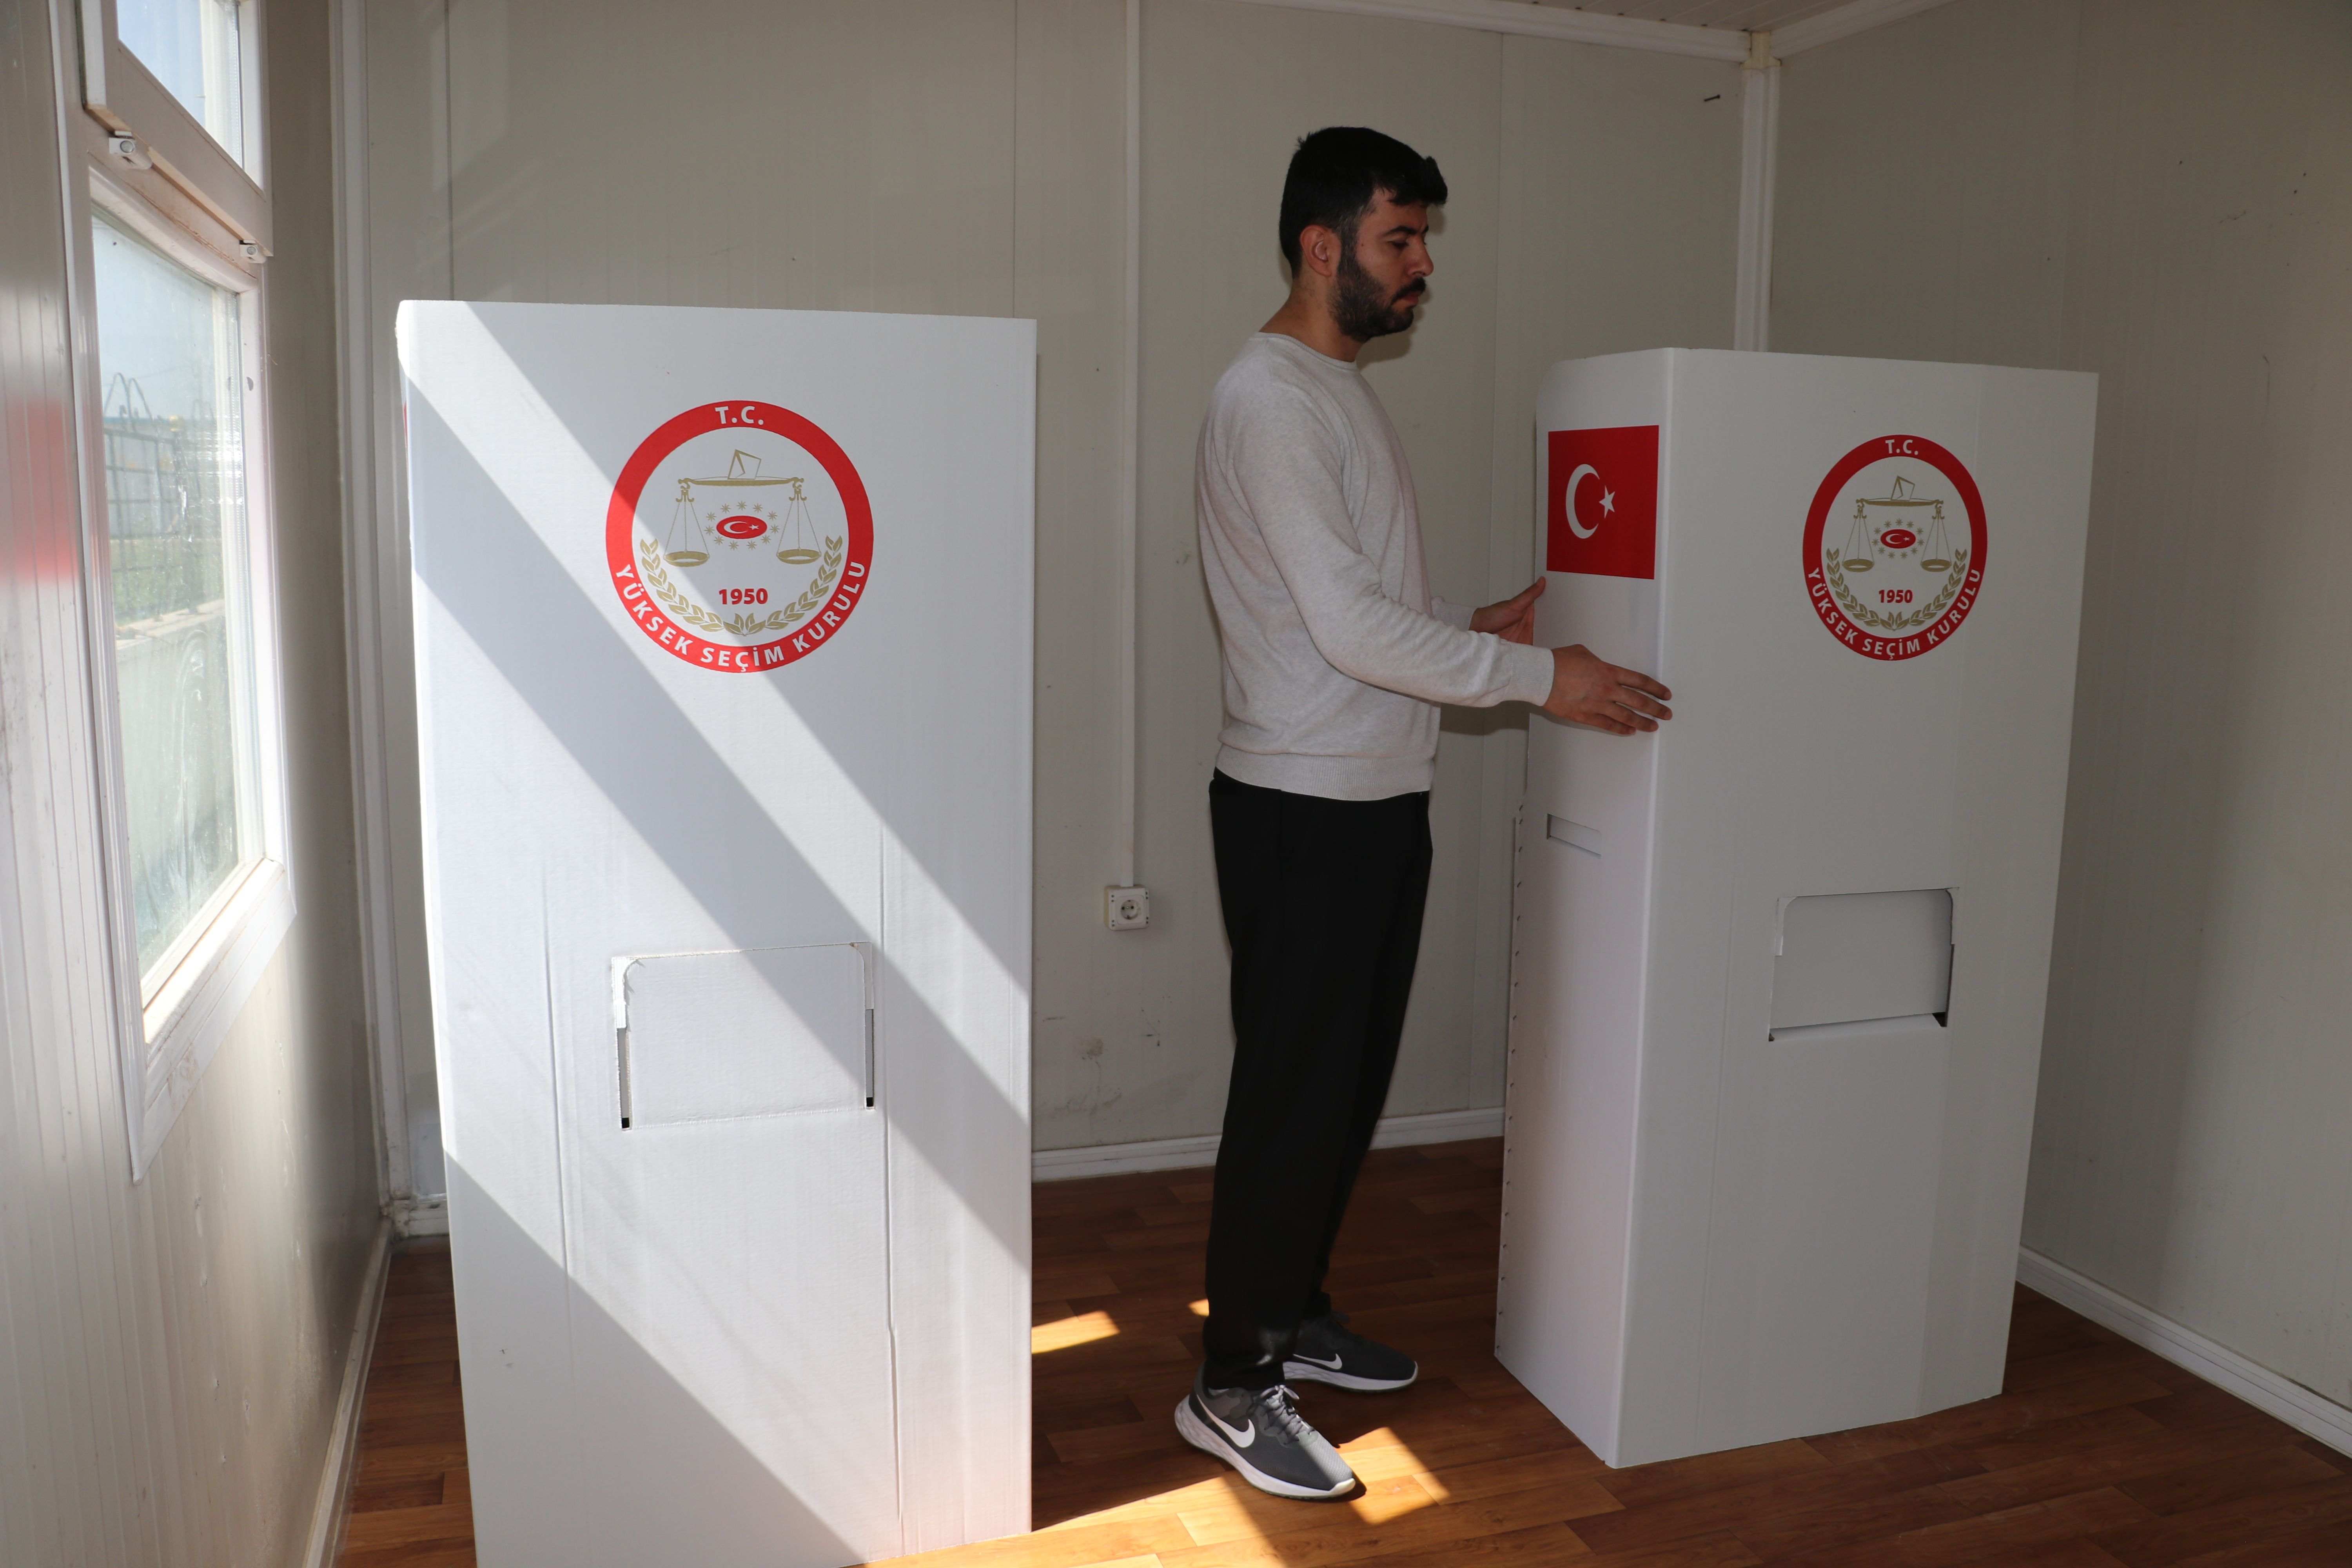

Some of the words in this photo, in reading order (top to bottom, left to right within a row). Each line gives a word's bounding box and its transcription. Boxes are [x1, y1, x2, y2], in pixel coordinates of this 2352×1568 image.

[715, 406, 764, 426] T.C.
[1885, 439, 1918, 456] T.C.
[719, 588, 768, 605] 1950
[1878, 589, 1913, 603] 1950
[616, 564, 693, 655] YÜKSEK
[700, 646, 784, 672] SEÇİM
[792, 561, 866, 653] KURULU
[1808, 567, 1858, 645] YÜKSEK
[1862, 636, 1920, 660] SEÇİM
[1926, 569, 1980, 644] KURULU
